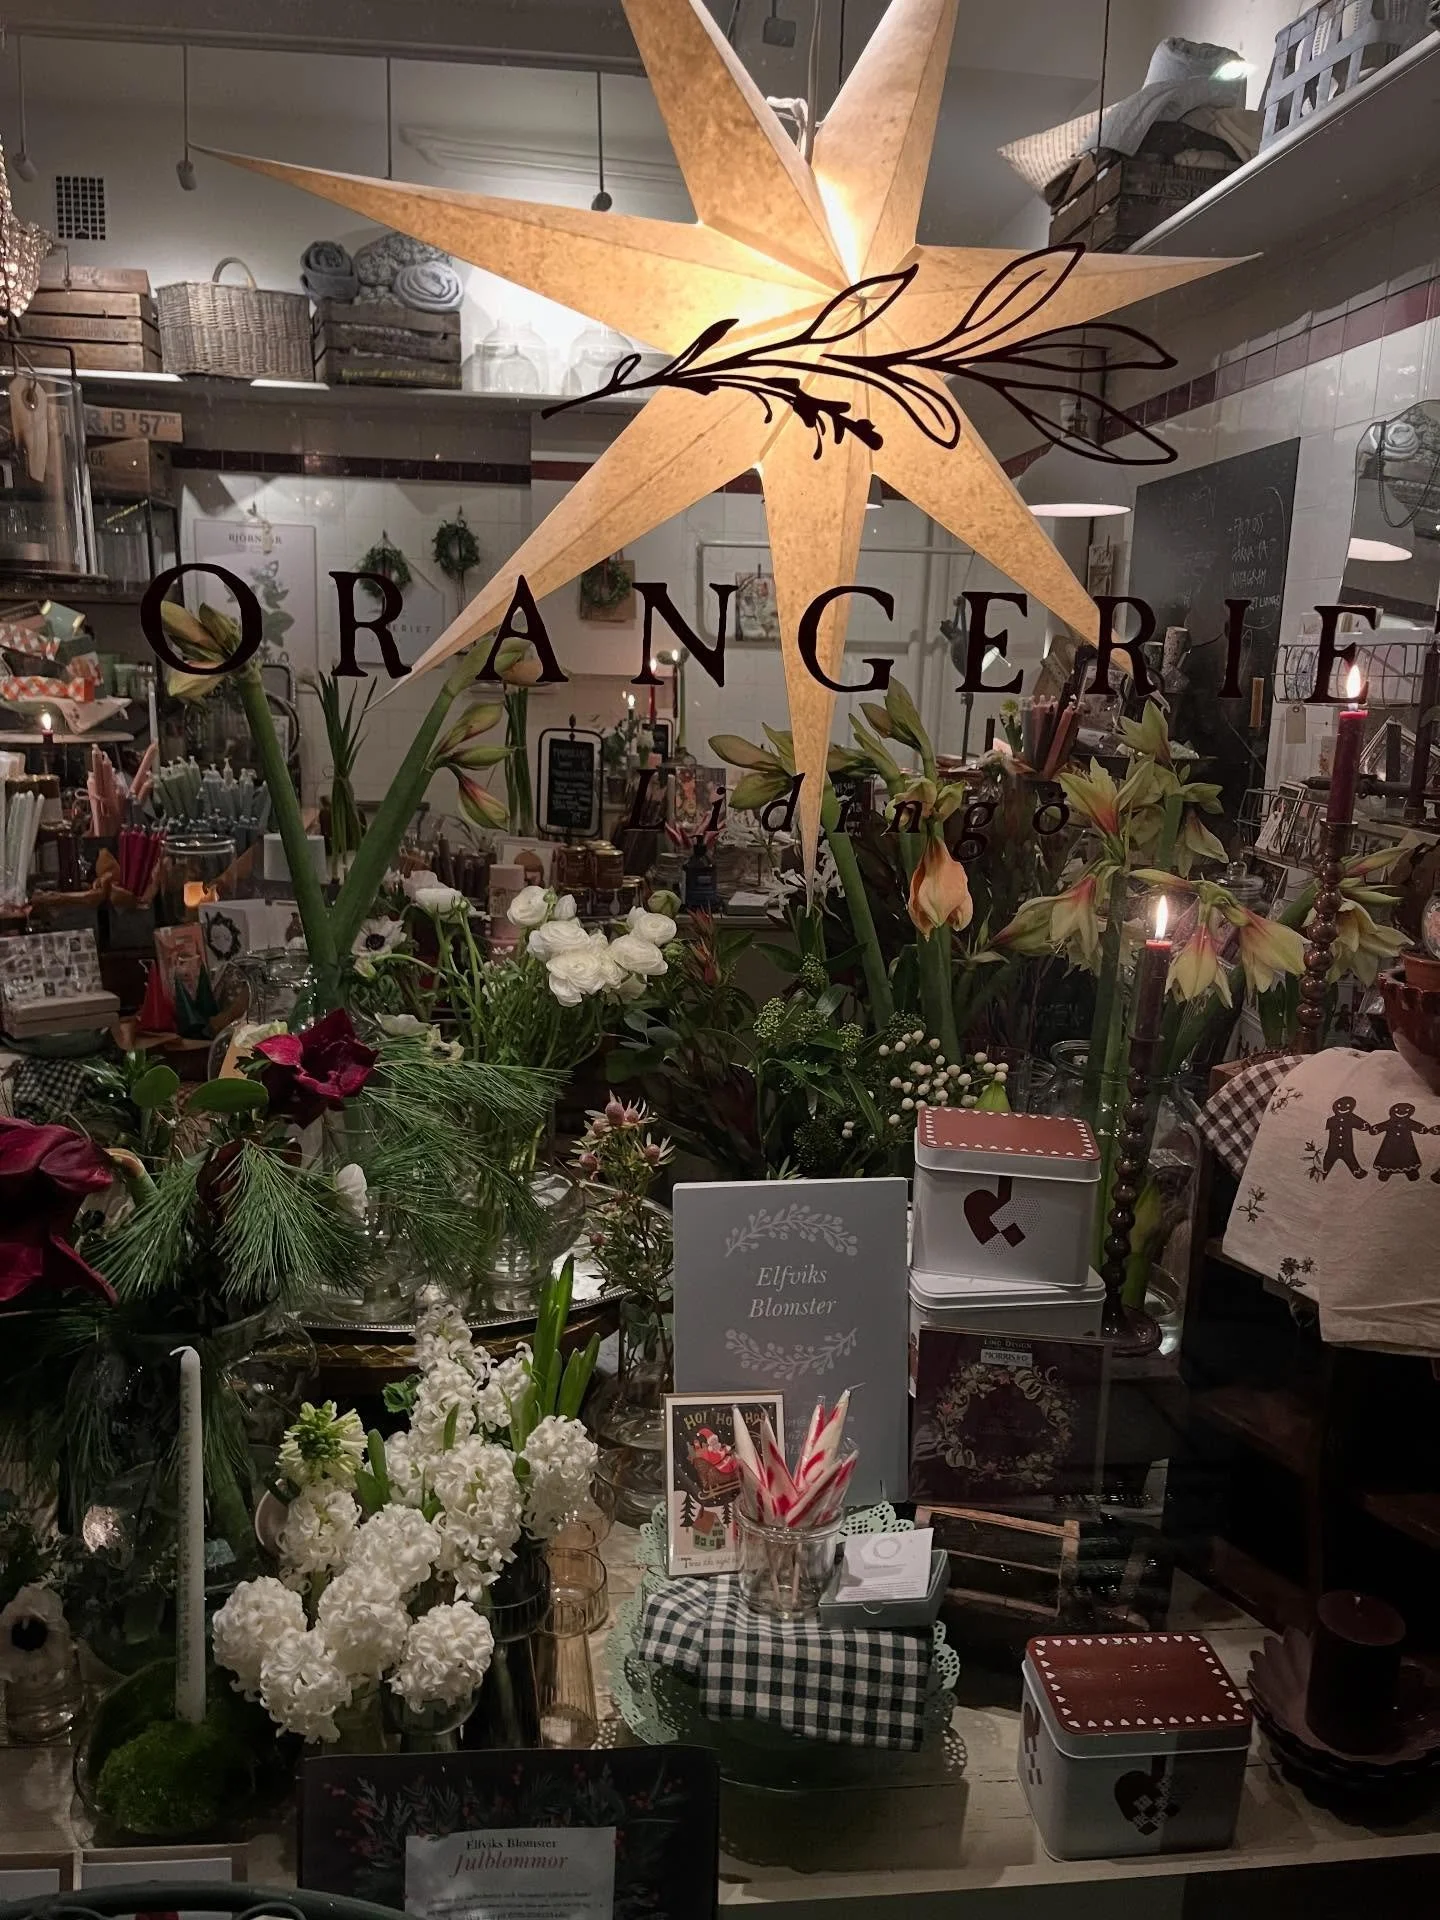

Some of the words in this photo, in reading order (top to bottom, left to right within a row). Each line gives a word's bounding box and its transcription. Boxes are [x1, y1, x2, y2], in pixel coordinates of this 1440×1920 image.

[622, 768, 1070, 864] Lidingö
[755, 1264, 828, 1293] Elfviks
[749, 1297, 838, 1318] Blomster
[507, 1837, 557, 1850] Blomster
[449, 1851, 568, 1877] Julblommor
